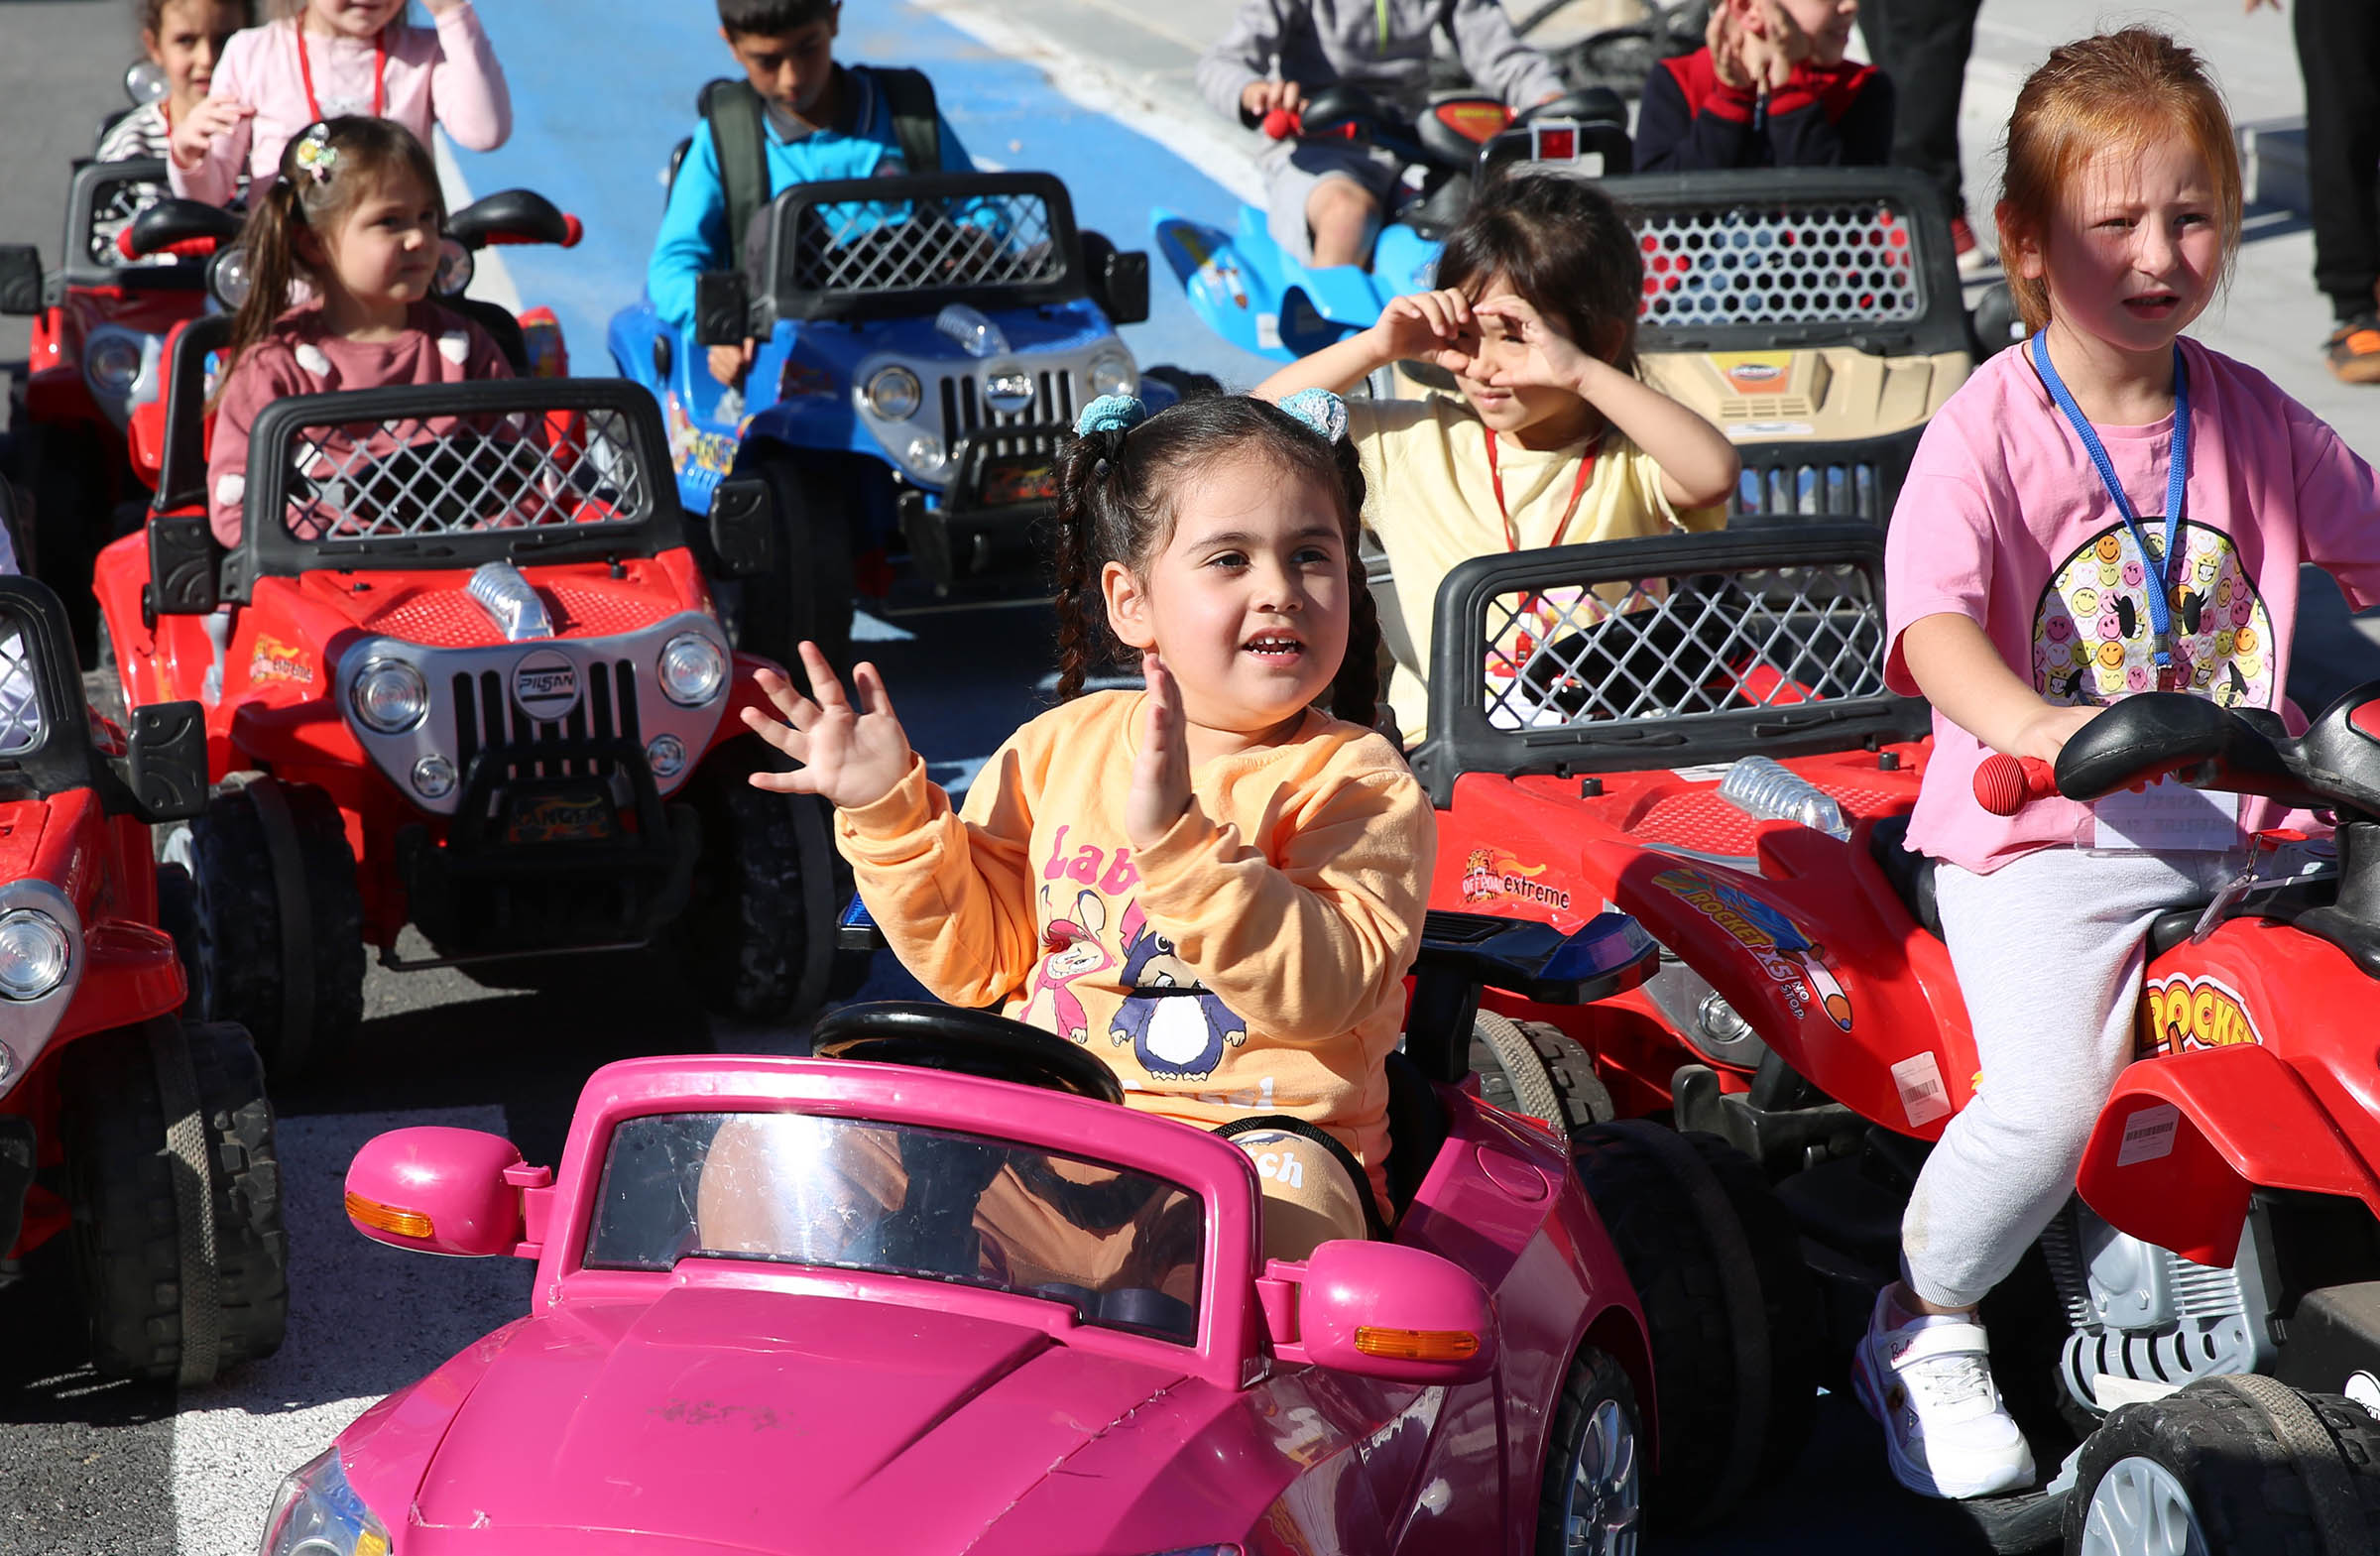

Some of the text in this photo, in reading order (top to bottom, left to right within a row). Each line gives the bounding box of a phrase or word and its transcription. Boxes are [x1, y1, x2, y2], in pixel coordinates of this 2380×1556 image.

[520, 675, 573, 692] PILSAN
[1043, 824, 1142, 897] Lab
[1503, 876, 1571, 910] extreme
[1687, 892, 1775, 946] ROCKET
[1779, 983, 1806, 1020] STOP
[1792, 980, 1811, 1003] NO
[2144, 988, 2255, 1047] ROCKE
[1245, 1146, 1304, 1189] tch
